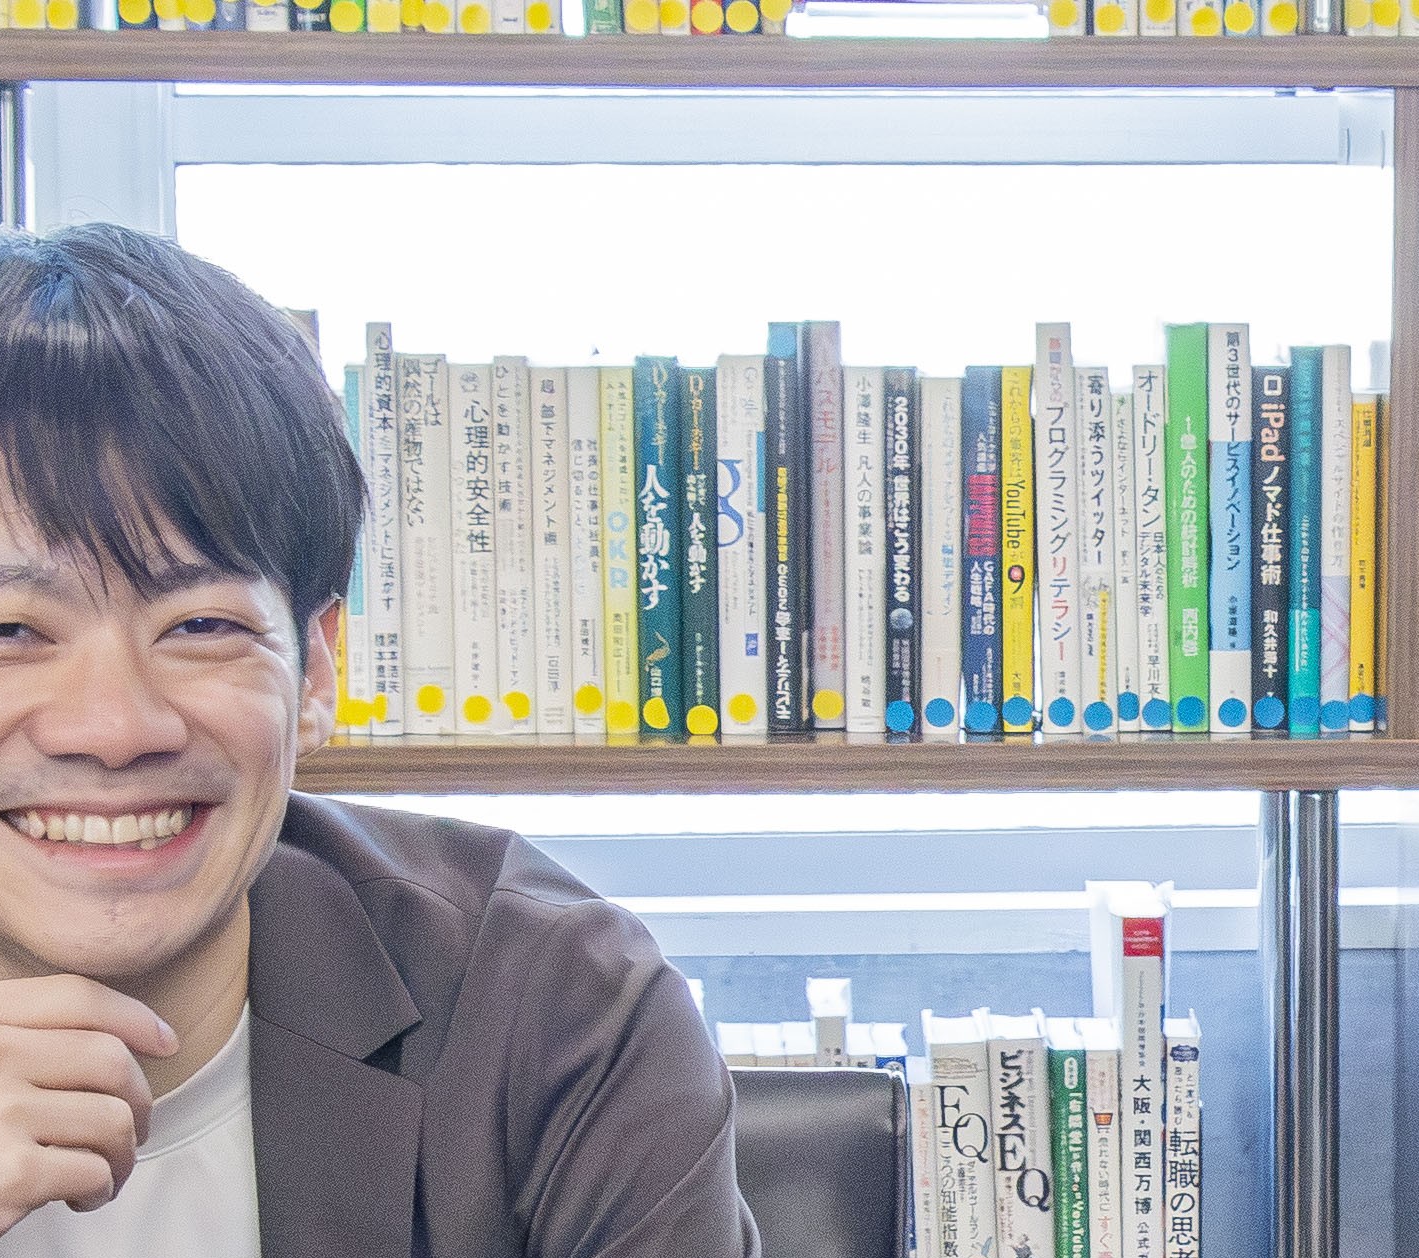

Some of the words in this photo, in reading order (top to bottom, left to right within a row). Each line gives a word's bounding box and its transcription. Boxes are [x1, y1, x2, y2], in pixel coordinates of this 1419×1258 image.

[422, 358, 442, 429] ゴールは
[495, 363, 513, 514] ひとを動かす技術
[1138, 369, 1162, 529] オードリー・タン
[1224, 330, 1243, 573] 第3世代のサービスイノベーション
[464, 400, 492, 556] 心理的安全性
[640, 463, 670, 611] 人を動かす
[857, 456, 874, 558] 凡人の事業論
[1087, 374, 1107, 565] 寄り添うツイッター
[607, 510, 631, 590] OKR
[688, 512, 707, 595] 人を動かす
[937, 1085, 989, 1163] EQ
[940, 1126, 961, 1258] こころの知能指数
[1131, 1074, 1154, 1217] 大阪・関西万博
